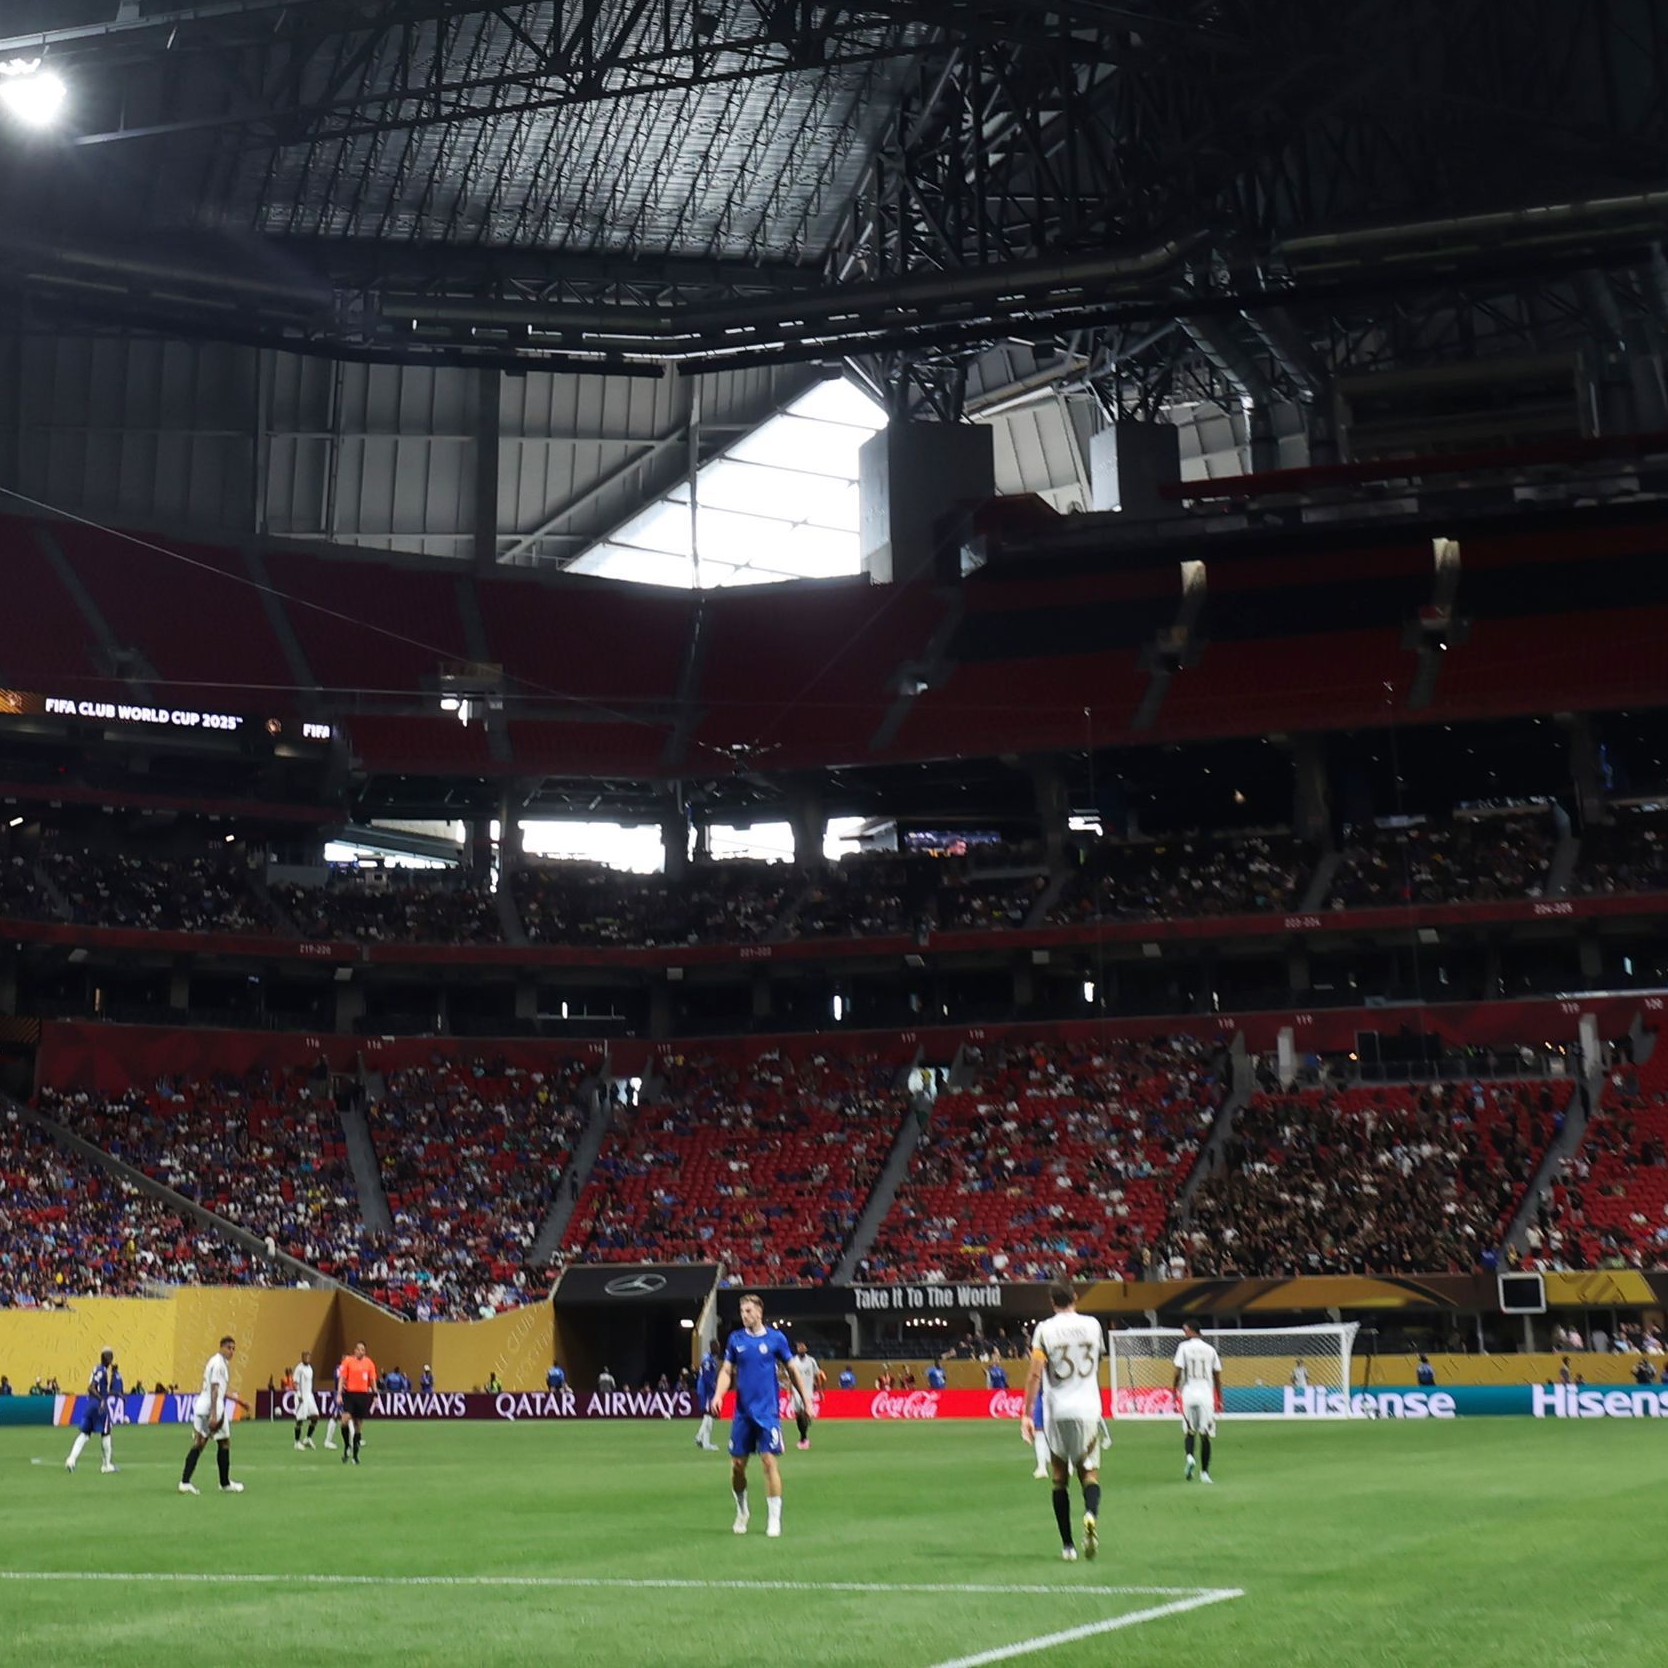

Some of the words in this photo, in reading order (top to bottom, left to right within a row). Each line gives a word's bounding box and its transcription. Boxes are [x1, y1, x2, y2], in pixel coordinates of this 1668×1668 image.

[45, 697, 77, 715] FIFA
[78, 701, 116, 719] CLUB
[117, 704, 170, 724] WORLD
[170, 710, 201, 726] CUP
[302, 723, 331, 739] FIFA
[854, 1289, 889, 1309] Take
[907, 1287, 926, 1308] To
[927, 1286, 955, 1307] The
[957, 1284, 1003, 1308] World
[1053, 1341, 1095, 1381] 33
[370, 1392, 467, 1418] AIRWAYS
[495, 1391, 576, 1421] QATAR
[587, 1390, 693, 1417] AIRWAYS
[1283, 1385, 1456, 1419] Hisense
